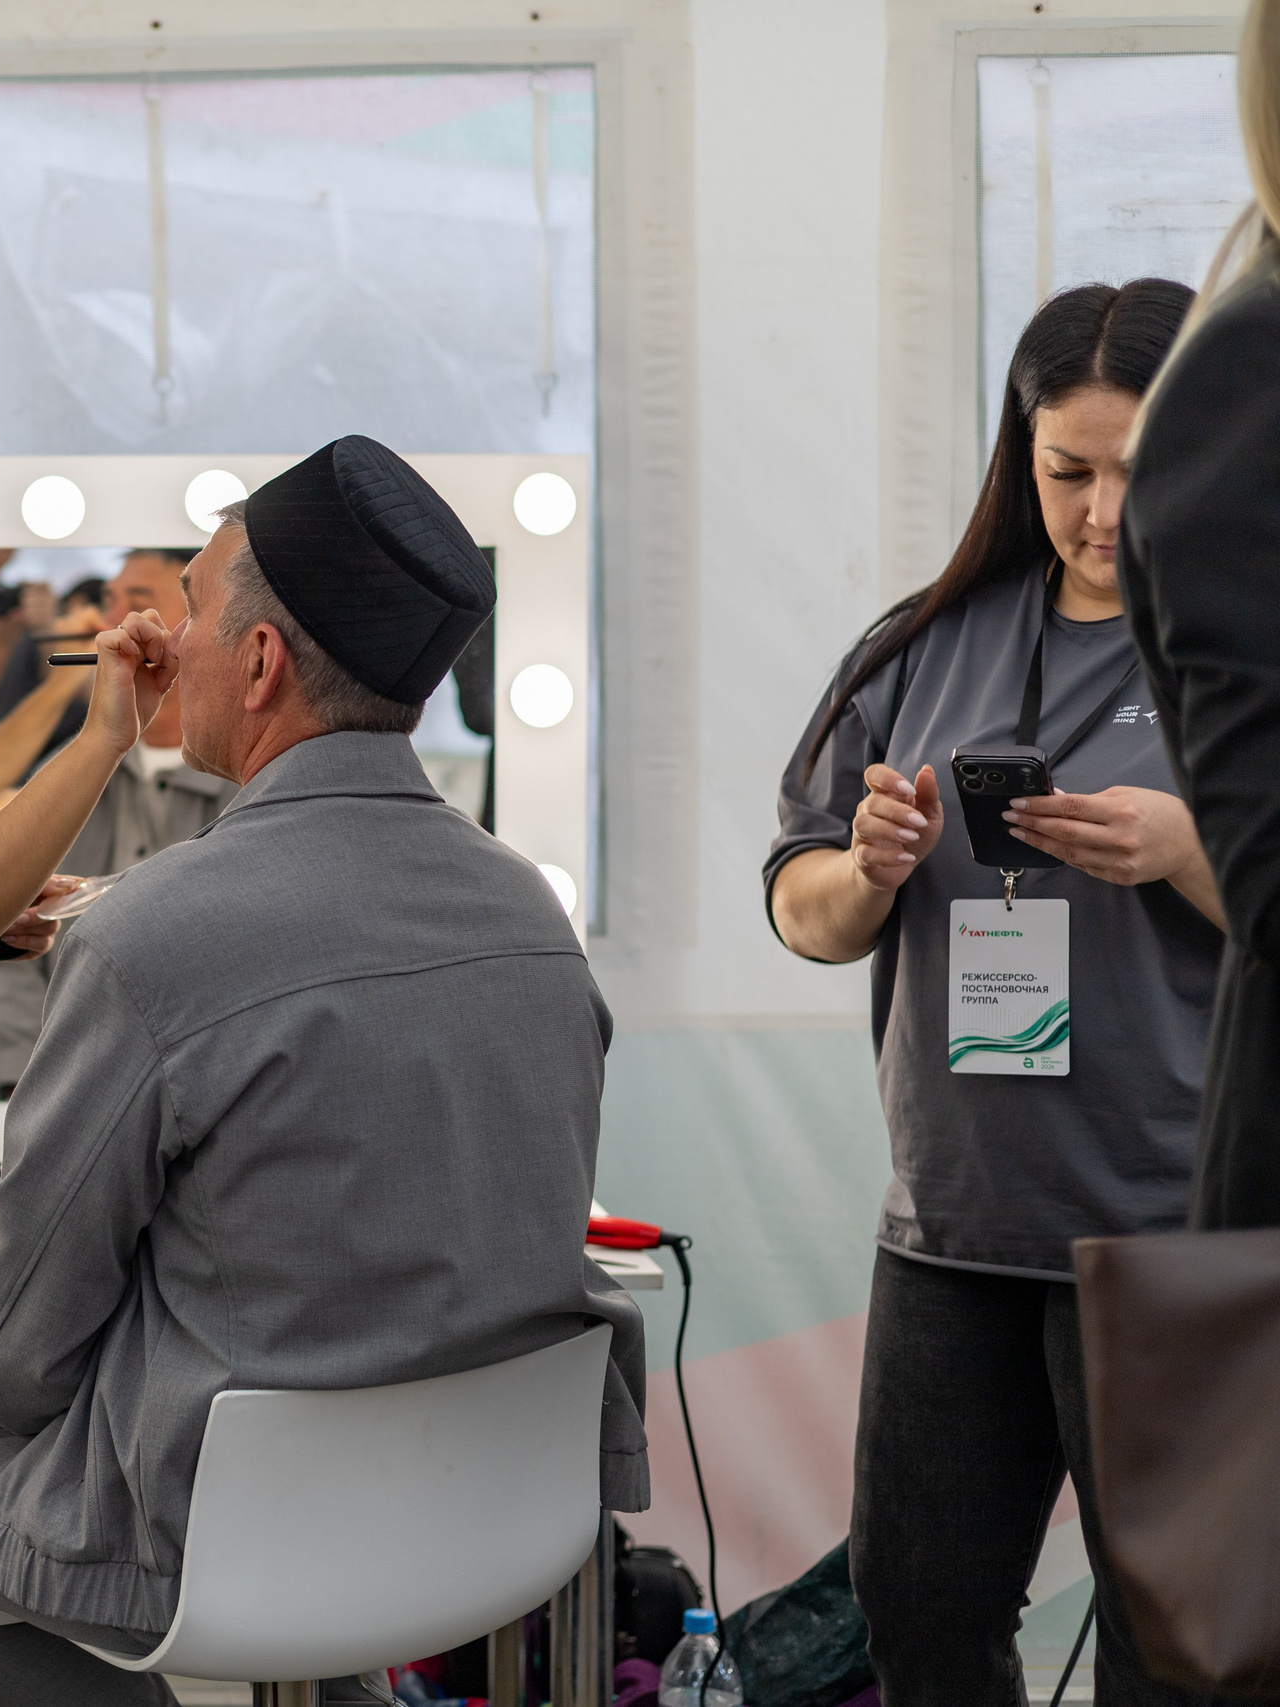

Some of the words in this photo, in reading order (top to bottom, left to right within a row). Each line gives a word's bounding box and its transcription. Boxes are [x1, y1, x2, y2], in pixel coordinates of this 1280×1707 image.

[961, 972, 1038, 982] РЕЖИССЕРСКО-
[961, 984, 1049, 994] ПОСТАНОВОЧНАЯ
[961, 996, 999, 1005] ГРУППА
